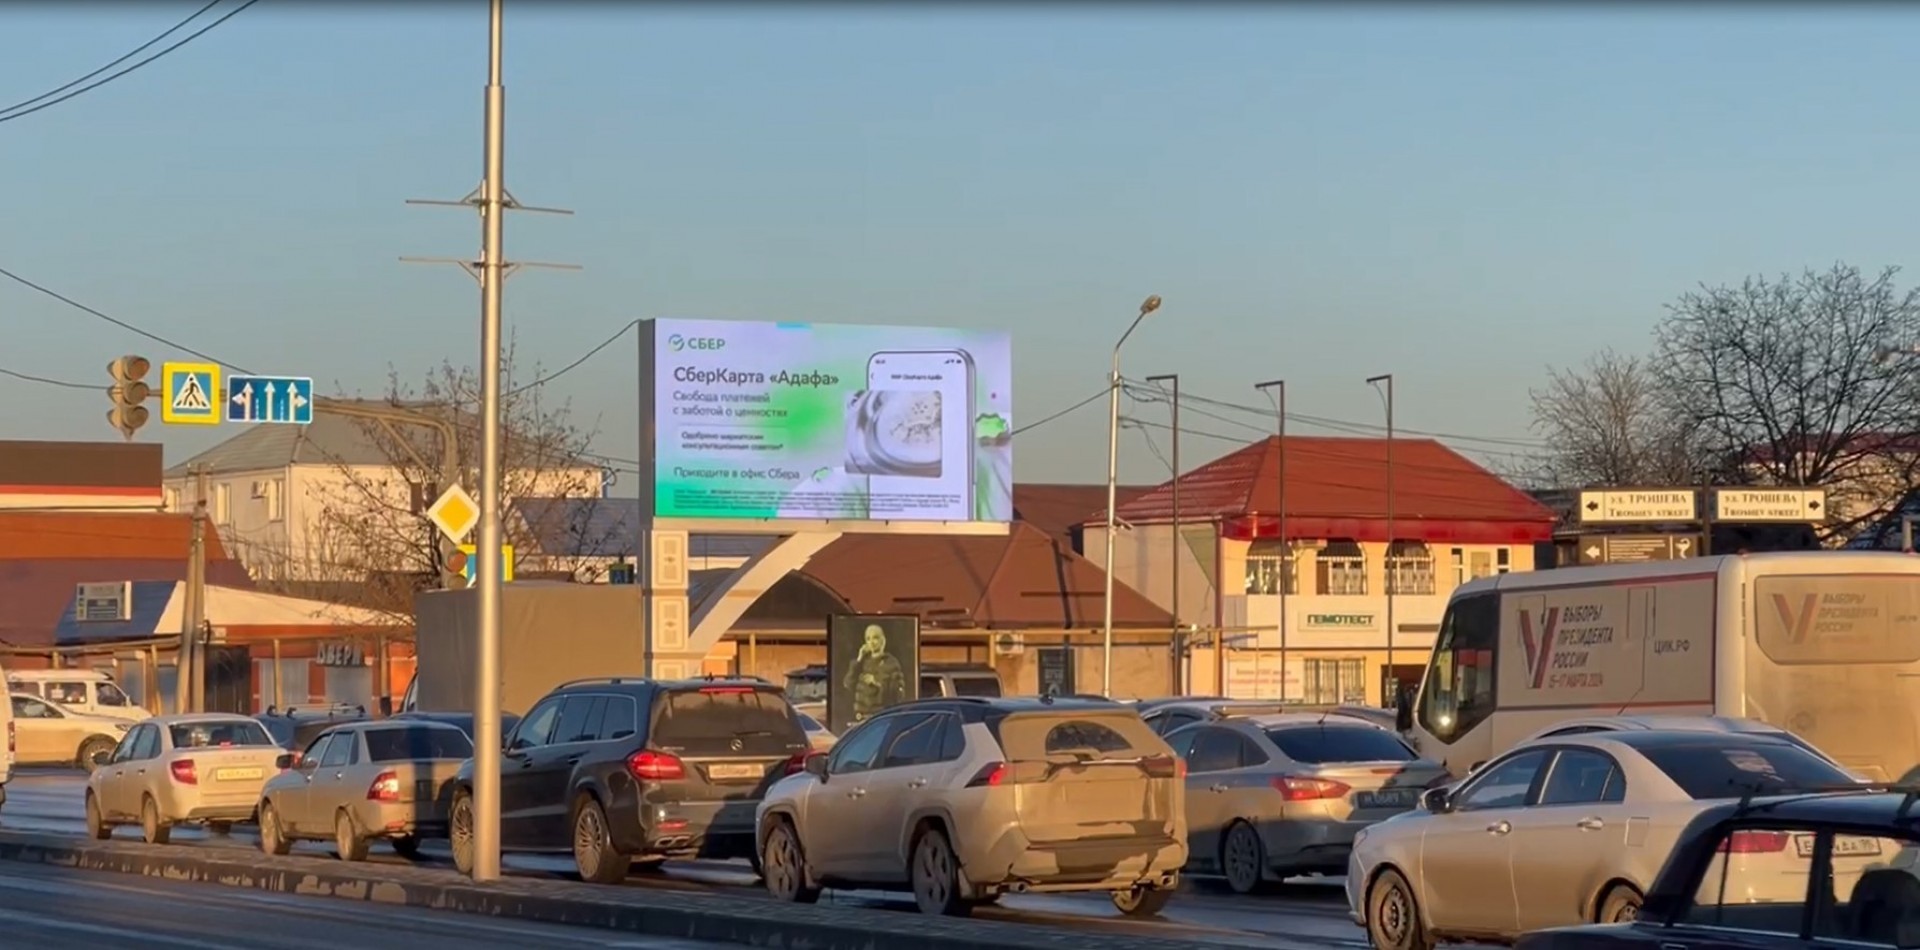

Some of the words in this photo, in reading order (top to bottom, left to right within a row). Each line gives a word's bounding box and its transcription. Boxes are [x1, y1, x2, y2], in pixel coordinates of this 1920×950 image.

[688, 338, 725, 350] СБЕР
[674, 367, 764, 386] СберКарта
[769, 369, 839, 387] «Адафа»
[673, 390, 719, 402] Свобода
[721, 392, 771, 403] платежей
[682, 405, 722, 416] заботой
[674, 467, 728, 479] Приходите
[741, 468, 765, 480] офис
[767, 468, 800, 480] Сбера
[1629, 494, 1687, 504] ТРОШЕВА
[1742, 493, 1797, 503] ТРОШЕВА
[1307, 614, 1374, 625] ГЕМОТЕСТ
[1562, 605, 1603, 623] ВЫБОРЫ
[1557, 627, 1613, 646] ПРЕЗИДЕНТА
[1654, 640, 1691, 655] ЦИК.РФ
[1552, 651, 1589, 669] РОССИИ
